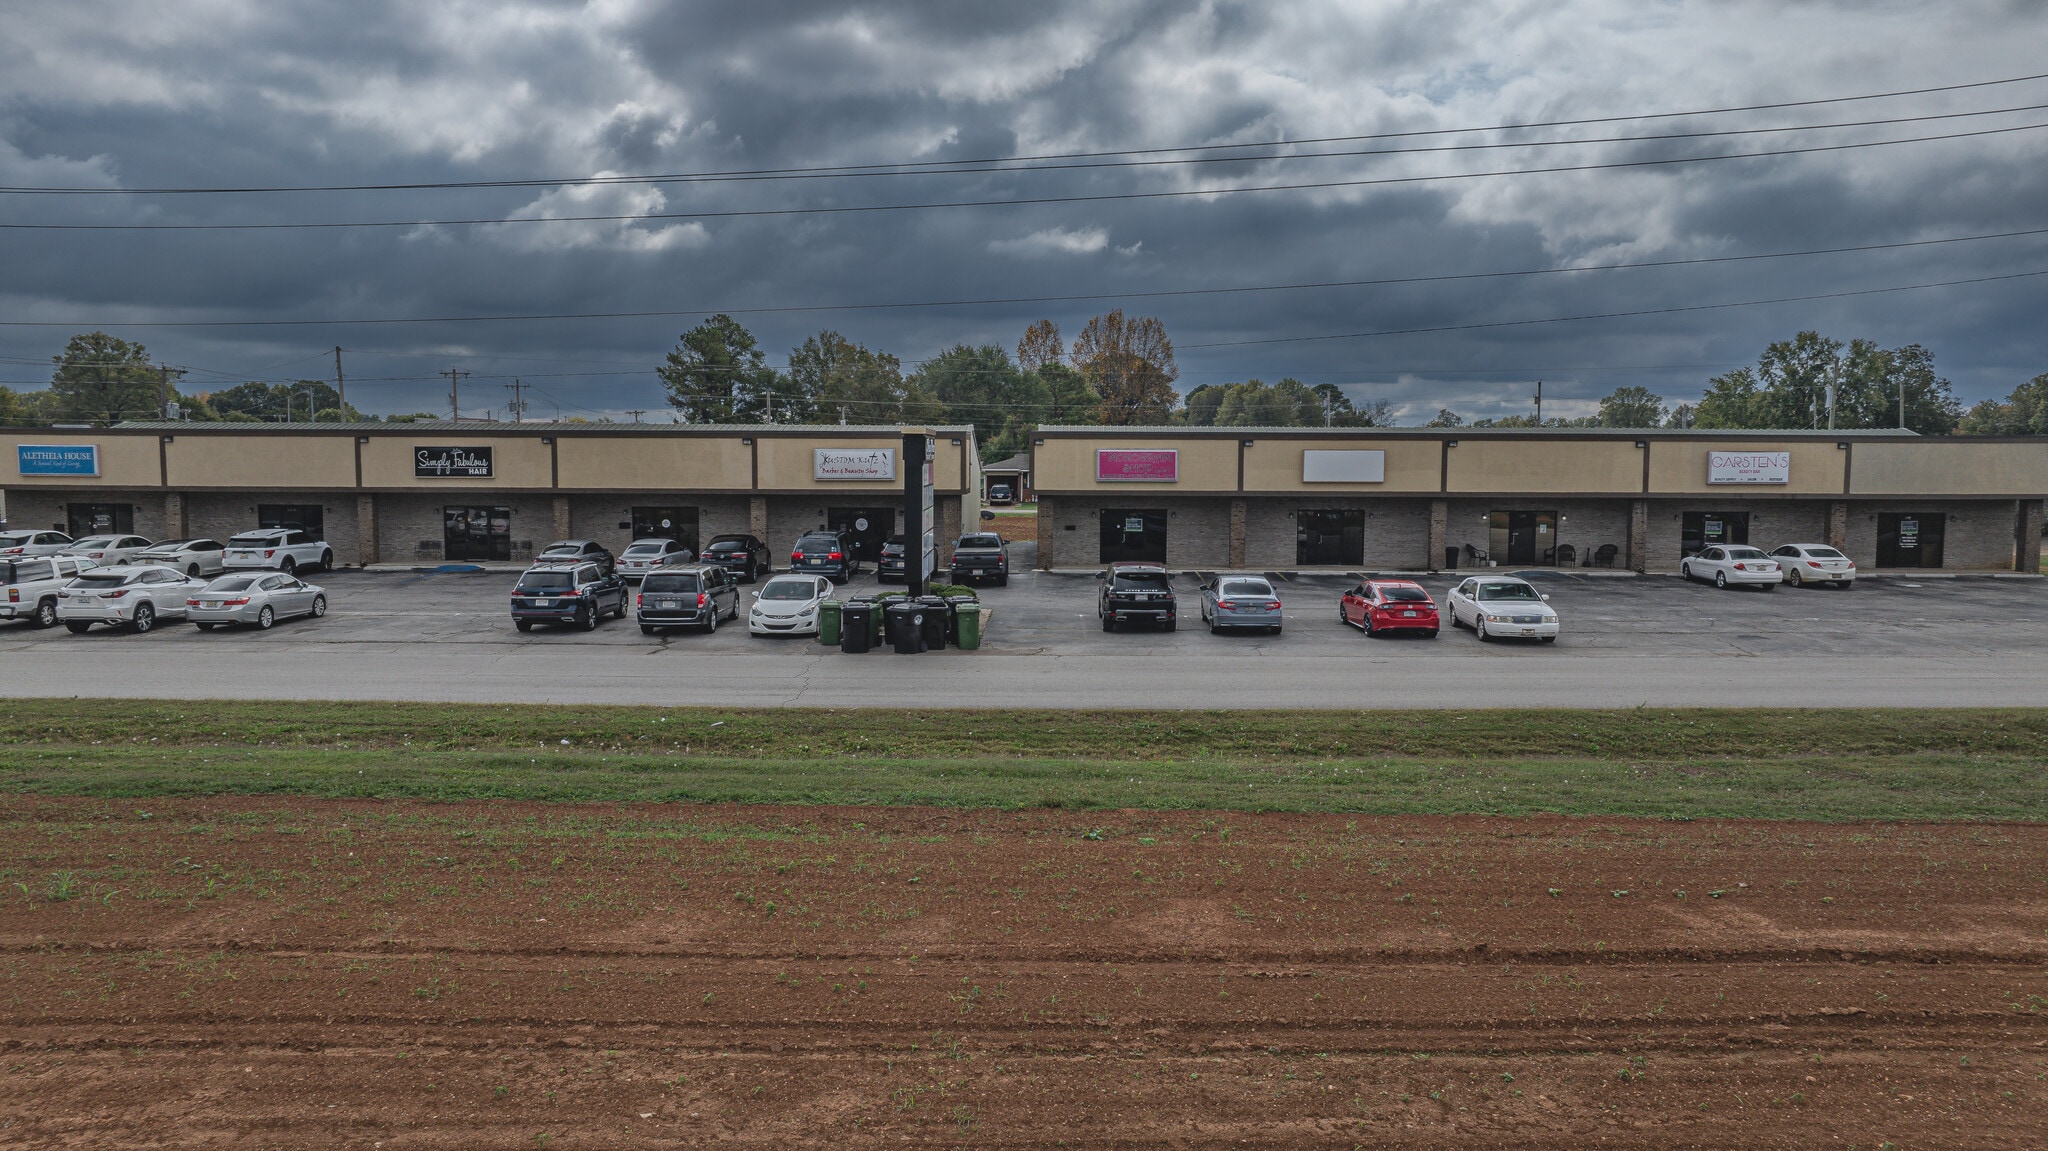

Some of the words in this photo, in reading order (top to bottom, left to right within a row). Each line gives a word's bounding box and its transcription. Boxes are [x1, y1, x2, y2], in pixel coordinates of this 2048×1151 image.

[22, 452, 62, 460] ALETHEIA
[64, 452, 92, 460] HOUSE
[1711, 453, 1789, 468] CARSTEN'S
[418, 450, 451, 475] Simply
[451, 450, 488, 468] Fabulous
[844, 467, 865, 476] Beauty
[865, 467, 879, 476] Shop
